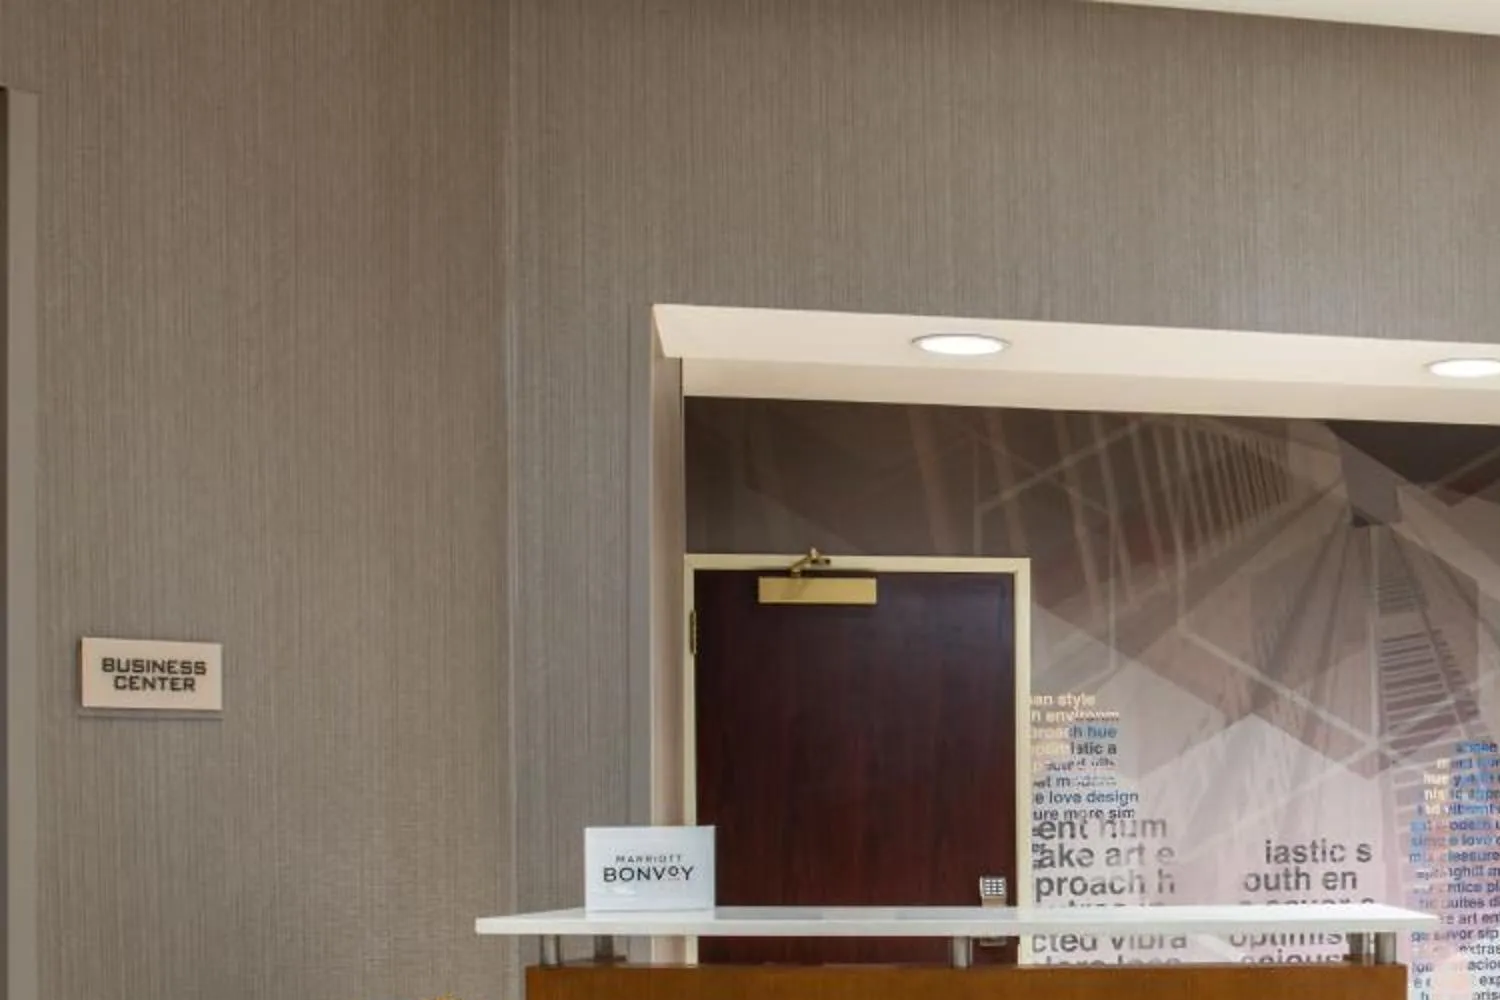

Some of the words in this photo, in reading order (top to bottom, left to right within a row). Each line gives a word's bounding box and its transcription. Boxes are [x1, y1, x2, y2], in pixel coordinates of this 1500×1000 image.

[102, 657, 207, 675] BUSINESS
[114, 675, 196, 692] CENTER
[1057, 692, 1095, 711] style
[1087, 725, 1117, 738] hue
[1049, 790, 1082, 803] love
[1086, 790, 1139, 806] design
[615, 854, 682, 863] MARRIOTT
[1106, 842, 1146, 866] art
[1156, 847, 1175, 864] e
[1265, 839, 1346, 864] iastic
[1356, 843, 1373, 863] s
[603, 866, 693, 882] BONVOY
[1244, 866, 1311, 892] outh
[1322, 870, 1358, 891] en
[1036, 869, 1145, 900] proach
